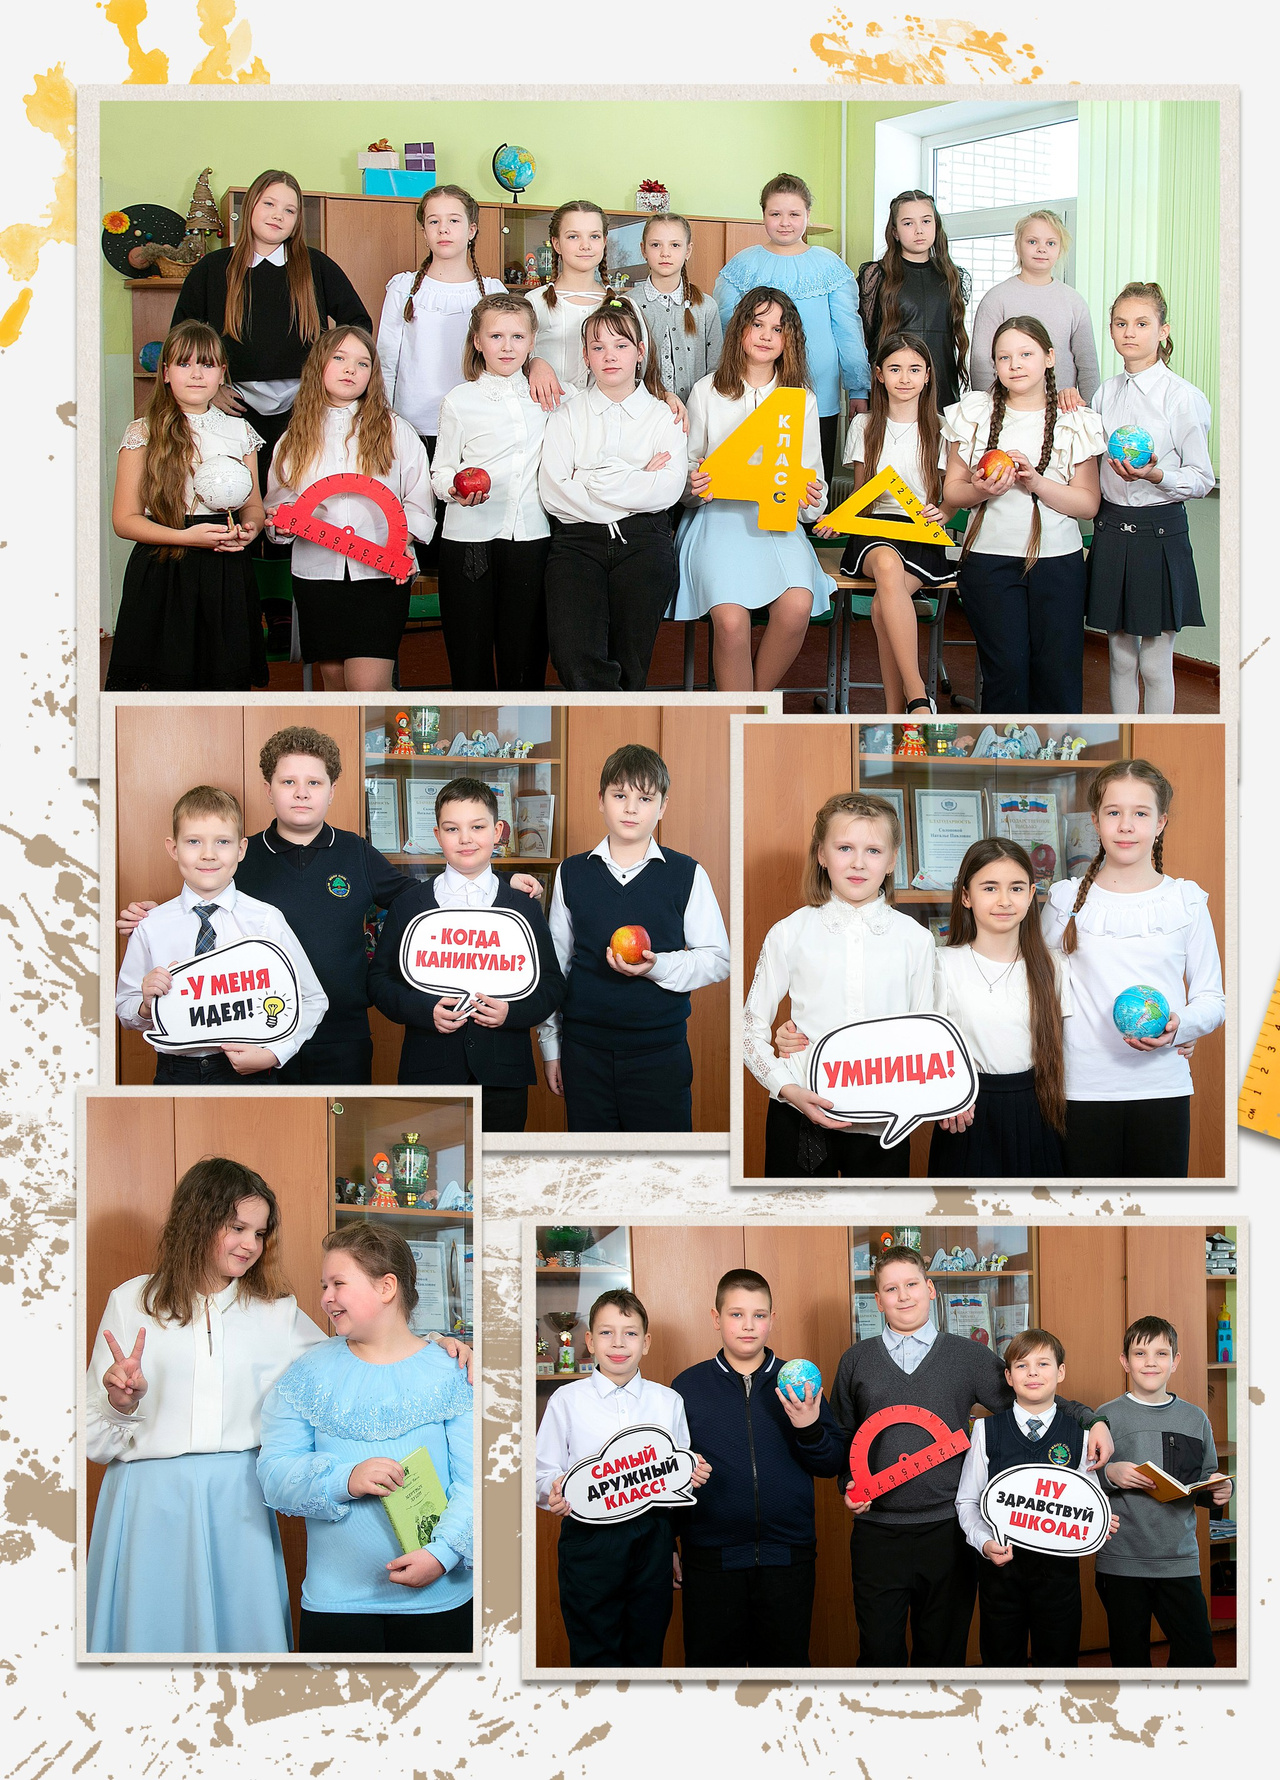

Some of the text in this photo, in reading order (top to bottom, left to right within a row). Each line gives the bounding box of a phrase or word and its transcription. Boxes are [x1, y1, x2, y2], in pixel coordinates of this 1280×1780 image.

[698, 387, 817, 532] 4
[773, 414, 791, 503] КЛАСС
[289, 518, 298, 527] 8
[897, 487, 905, 495] 2
[933, 531, 940, 539] 6
[303, 524, 311, 533] 7
[319, 530, 326, 538] 6
[334, 537, 341, 545] 5
[363, 549, 370, 557] 3
[377, 555, 384, 563] 2
[440, 928, 501, 949] КОГДА
[415, 950, 526, 974] КАНИКУЛЫ?
[210, 968, 271, 996] МЕНЯ
[189, 998, 254, 1028] ИДЕЯ!
[822, 1050, 955, 1088] УМНИЦА!
[591, 1444, 657, 1479] САМЫЙ
[938, 1448, 945, 1456] 2
[587, 1455, 679, 1502] ДРУЖНЫЙ
[889, 1475, 895, 1483] 6
[901, 1468, 908, 1476] 5
[604, 1477, 667, 1511] КЛАСС!
[864, 1488, 870, 1496] 8
[877, 1482, 883, 1490] 7
[1035, 1478, 1067, 1500] НУ
[996, 1491, 1094, 1523] ЗДРАВСТВУЙ
[1009, 1511, 1089, 1541] ШКОЛА!
